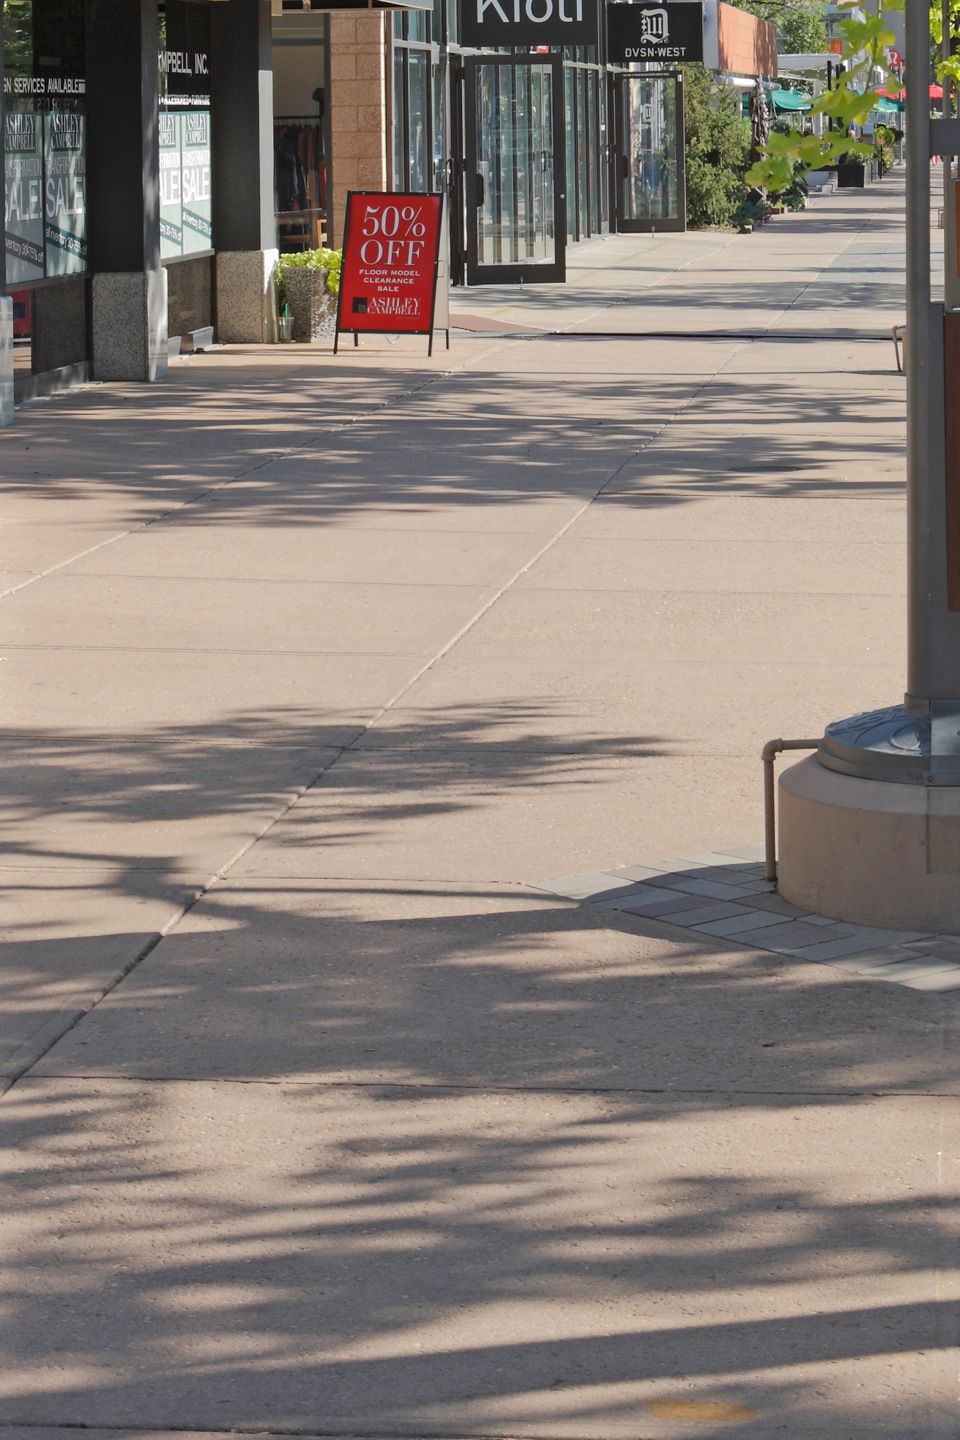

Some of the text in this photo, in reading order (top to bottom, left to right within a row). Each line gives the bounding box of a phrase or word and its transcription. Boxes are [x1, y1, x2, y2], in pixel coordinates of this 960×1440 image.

[194, 53, 209, 74] INC.
[14, 77, 45, 93] SERVICES
[47, 78, 79, 94] AVAILABLE
[52, 113, 80, 133] ASHLEY
[362, 205, 426, 237] 50%
[360, 239, 425, 266] OFF
[363, 277, 415, 285] CLEARANCE
[366, 306, 421, 316] CAMPBELL
[370, 297, 421, 309] ASHLEY
